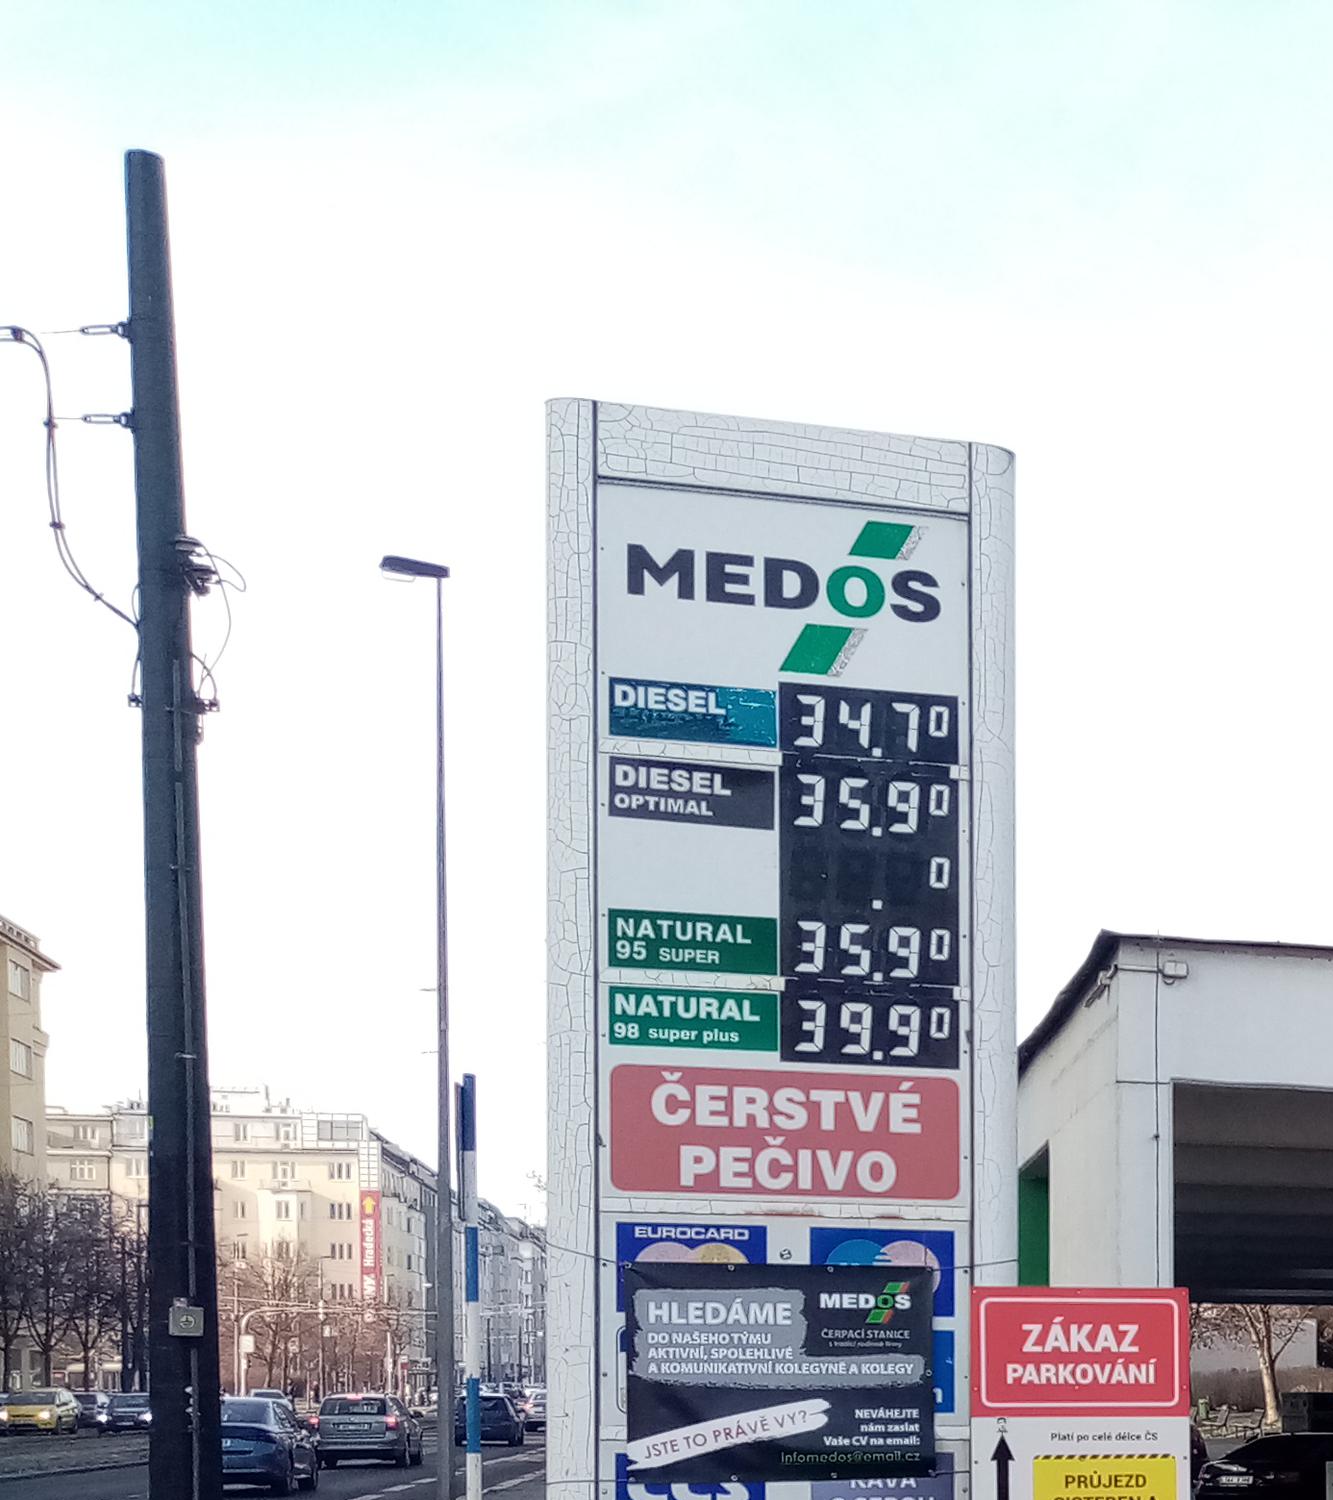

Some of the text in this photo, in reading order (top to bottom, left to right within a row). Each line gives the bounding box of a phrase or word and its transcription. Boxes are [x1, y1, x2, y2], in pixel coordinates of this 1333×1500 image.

[626, 543, 942, 623] MEDOS
[613, 684, 727, 716] DIESEL
[614, 764, 732, 796] DIESEL
[613, 793, 714, 817] OPTIMAL
[615, 917, 752, 945] NATURAL
[615, 941, 720, 965] 95 SUPER
[614, 993, 761, 1022] NATURAL
[613, 1023, 740, 1045] 98 super plus
[650, 1071, 923, 1134] ČERSTVÉ
[679, 1136, 898, 1191] PEČIVO
[634, 1226, 749, 1241] EUROCARD
[648, 1299, 793, 1326] HLEDÁME
[820, 1292, 912, 1310] MEDOS
[647, 1331, 772, 1345] DO NAŠEHO TÝMU
[821, 1328, 911, 1340] ČERPACÍ STANICE
[1021, 1316, 1139, 1353] ZÁKAZ
[647, 1346, 793, 1360] AKTIVNÍ, SPOLEHLIVÉ
[647, 1362, 658, 1374] A
[661, 1361, 773, 1375] KOMUNIKATIVNÍ
[849, 1363, 858, 1375] A
[861, 1363, 914, 1376] KOLEGY
[1006, 1359, 1157, 1386] PARKOVÁNÍ
[855, 1407, 920, 1419] NEVÁHEJTE
[644, 1409, 808, 1460] JSTE TO PRÁVĚ VY?
[860, 1422, 920, 1433] nám zaslat
[1050, 1432, 1074, 1441] Platí
[1076, 1434, 1089, 1443] po
[1092, 1432, 1112, 1441] celé
[1115, 1432, 1141, 1441] délce
[823, 1436, 921, 1447] Vaše CV na email:
[1064, 1470, 1147, 1489] PRŮJEZD
